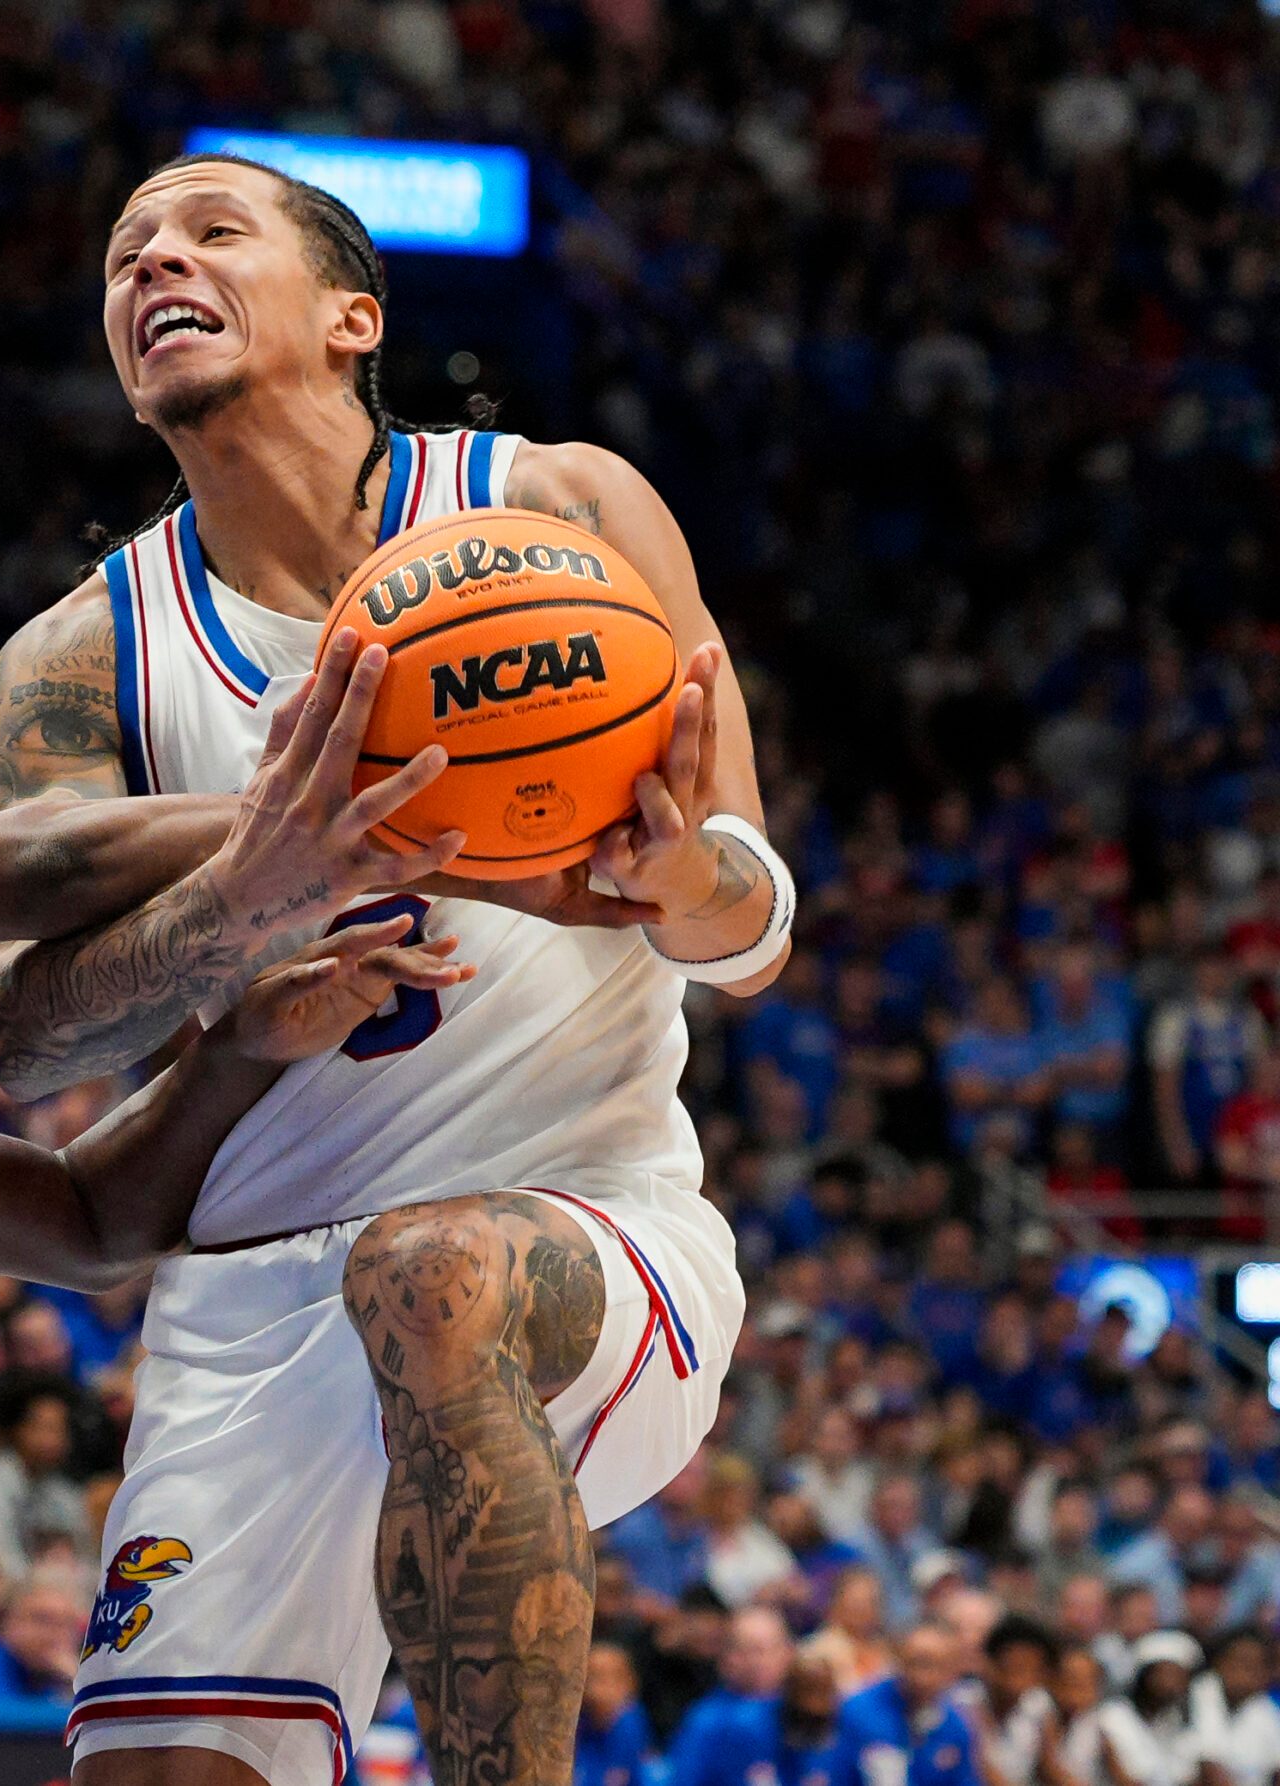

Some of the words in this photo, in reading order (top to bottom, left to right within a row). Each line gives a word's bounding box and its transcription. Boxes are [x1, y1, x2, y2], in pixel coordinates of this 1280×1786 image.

[360, 536, 611, 629] Wilson
[456, 583, 492, 599] EVO
[430, 629, 607, 720] NCAA
[436, 709, 510, 734] OFFICIAL
[513, 697, 563, 714] GAME
[567, 689, 609, 703] BALL
[95, 1599, 120, 1625] KU
